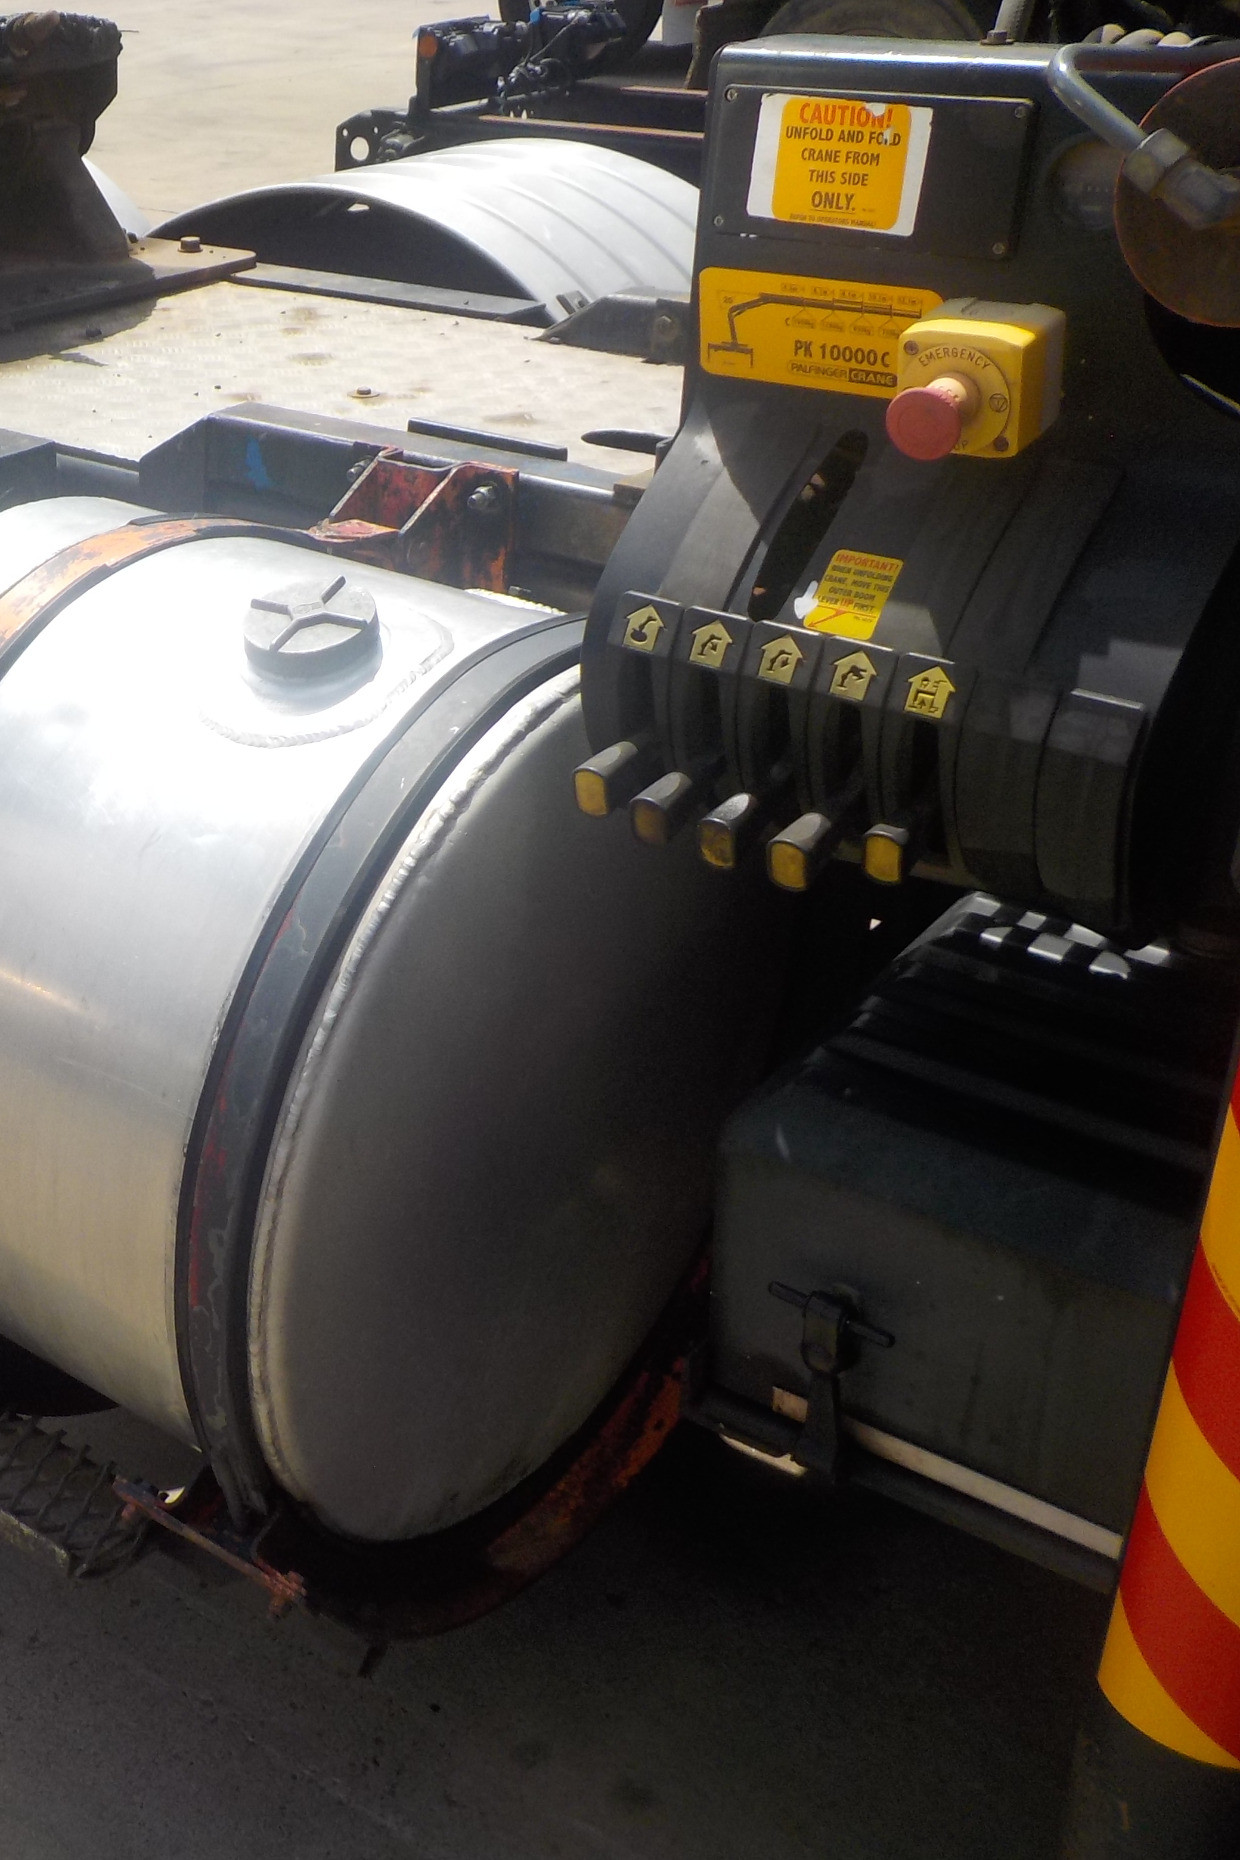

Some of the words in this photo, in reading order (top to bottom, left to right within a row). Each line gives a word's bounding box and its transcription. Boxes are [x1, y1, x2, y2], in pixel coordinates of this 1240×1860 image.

[799, 102, 894, 129] CAUTION!
[786, 125, 834, 142] UNFOLD
[838, 128, 864, 144] AND
[868, 129, 902, 147] FOD
[801, 147, 841, 164] CRANE
[845, 150, 880, 167] FROM
[809, 168, 836, 184] THIS
[840, 171, 869, 187] SIDE
[811, 190, 856, 212] ONLY.
[794, 339, 814, 358] PK
[918, 347, 990, 369] EMERGENCY
[791, 362, 847, 378] PALFINGER
[835, 553, 899, 571] IMPORTANT!
[829, 586, 853, 597] OUTER
[853, 591, 876, 600] BOOM
[851, 579, 872, 589] MOVE
[841, 597, 854, 607] UP
